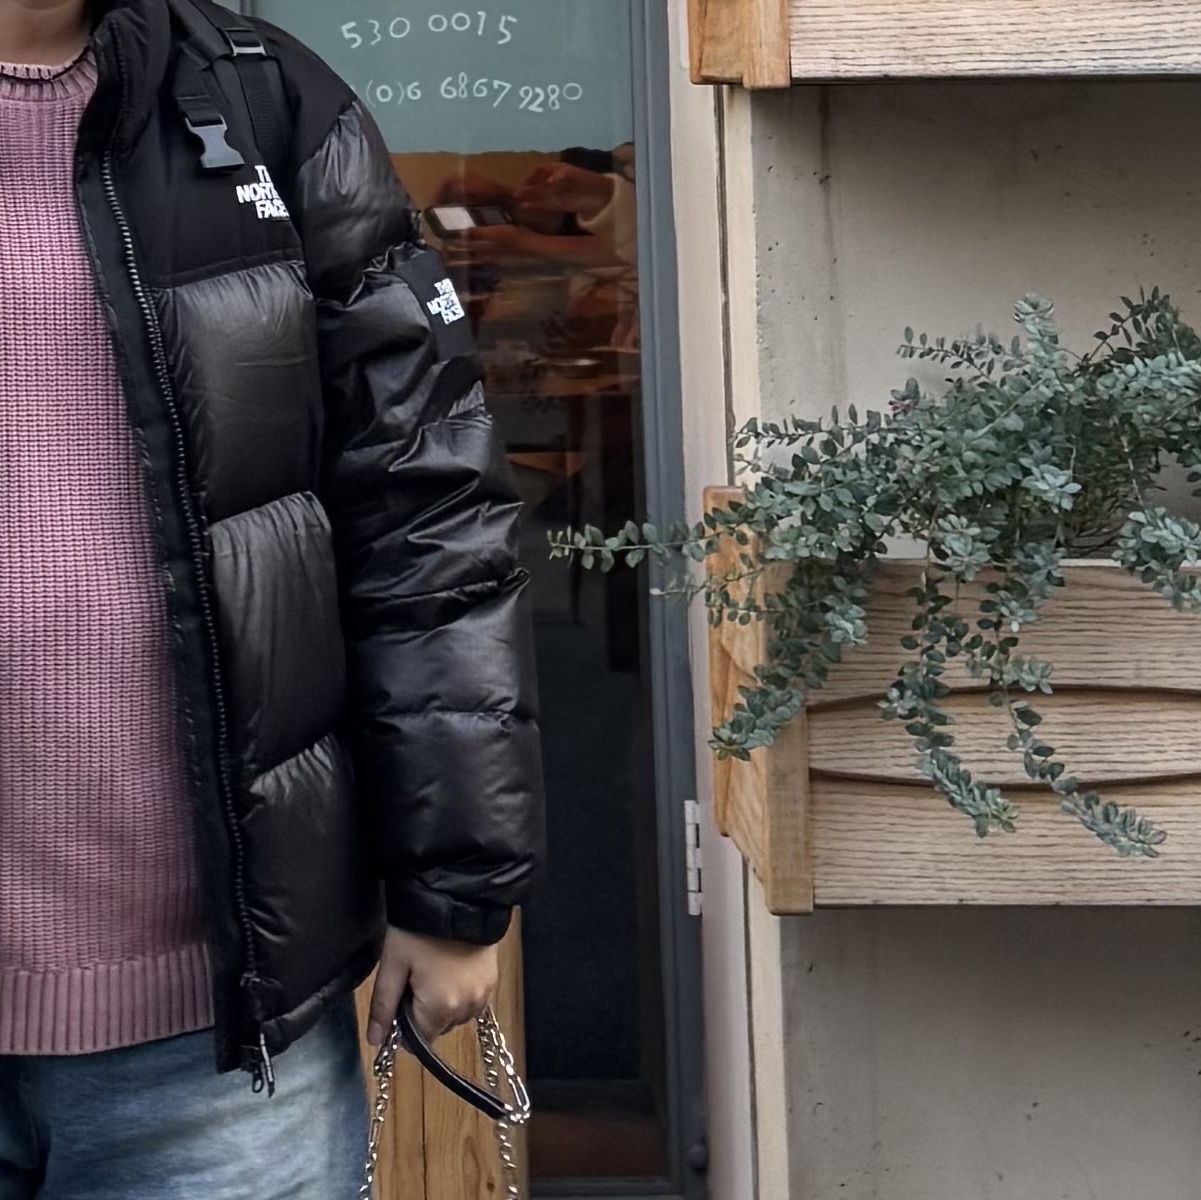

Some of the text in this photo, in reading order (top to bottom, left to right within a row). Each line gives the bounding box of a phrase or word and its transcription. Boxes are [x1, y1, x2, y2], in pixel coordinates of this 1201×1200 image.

[341, 11, 517, 48] 530 0015
[440, 72, 512, 108] 6867
[519, 83, 582, 113] 9280
